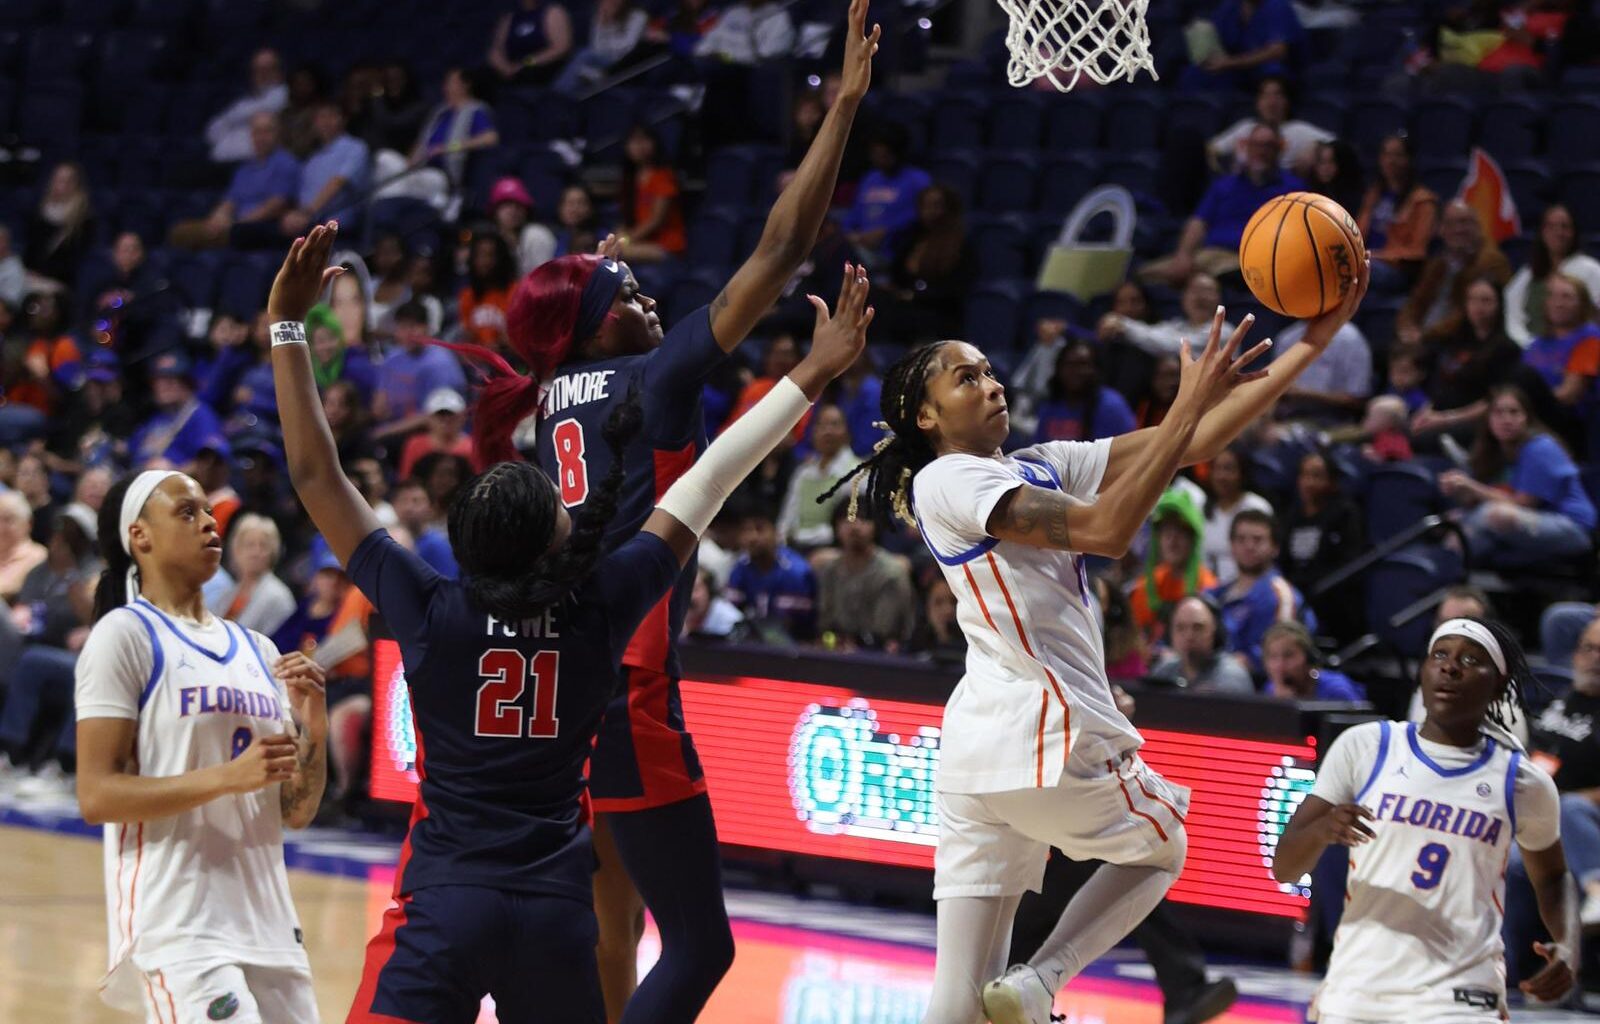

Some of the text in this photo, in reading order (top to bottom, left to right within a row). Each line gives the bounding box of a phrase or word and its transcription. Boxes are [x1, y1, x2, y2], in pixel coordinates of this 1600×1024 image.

[552, 417, 589, 508] 8
[475, 648, 560, 738] 21
[1376, 792, 1503, 847] FLORIDA
[1410, 841, 1451, 891] 9
